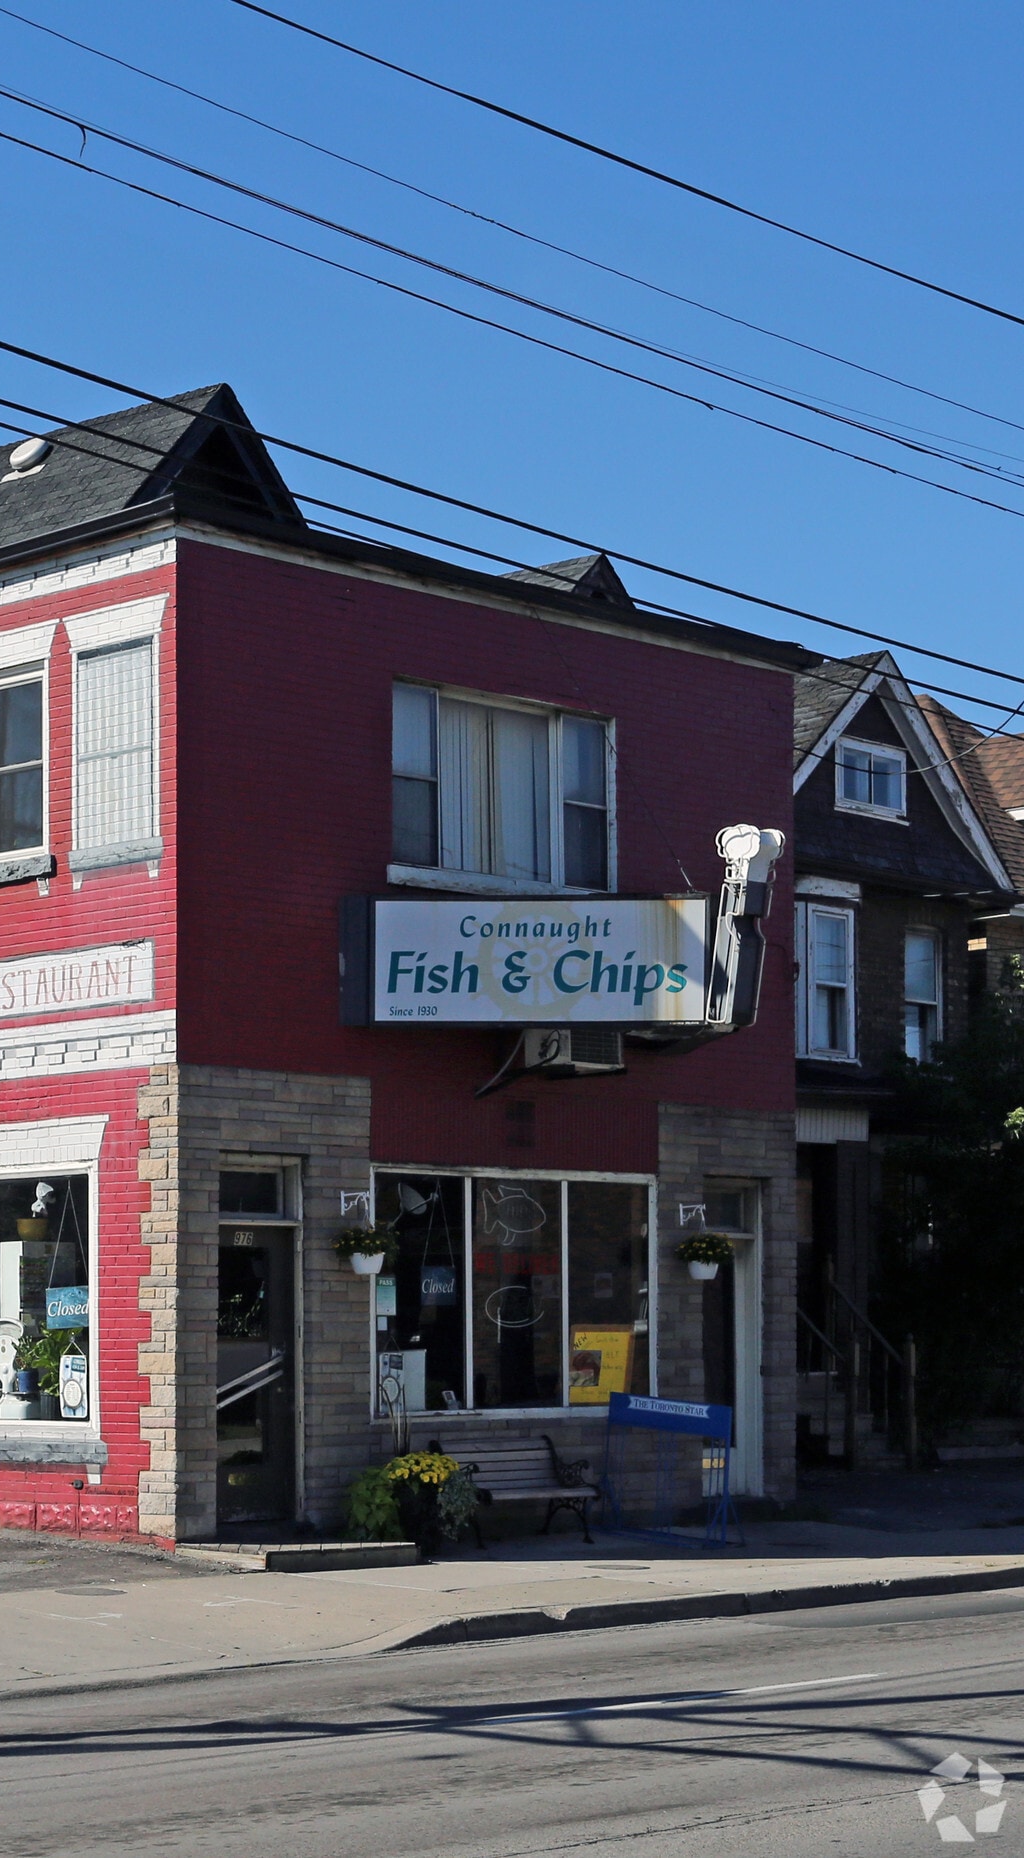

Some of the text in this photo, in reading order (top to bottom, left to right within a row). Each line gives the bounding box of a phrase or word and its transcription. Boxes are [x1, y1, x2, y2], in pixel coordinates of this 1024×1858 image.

[459, 915, 612, 943] Connaught
[387, 949, 689, 1006] Fish & Chips
[389, 1005, 438, 1017] Since 1930
[234, 1232, 253, 1245] 976
[422, 1278, 455, 1294] Closed
[47, 1300, 89, 1317] Closed
[634, 1398, 704, 1416] THE TORONTO STAR
